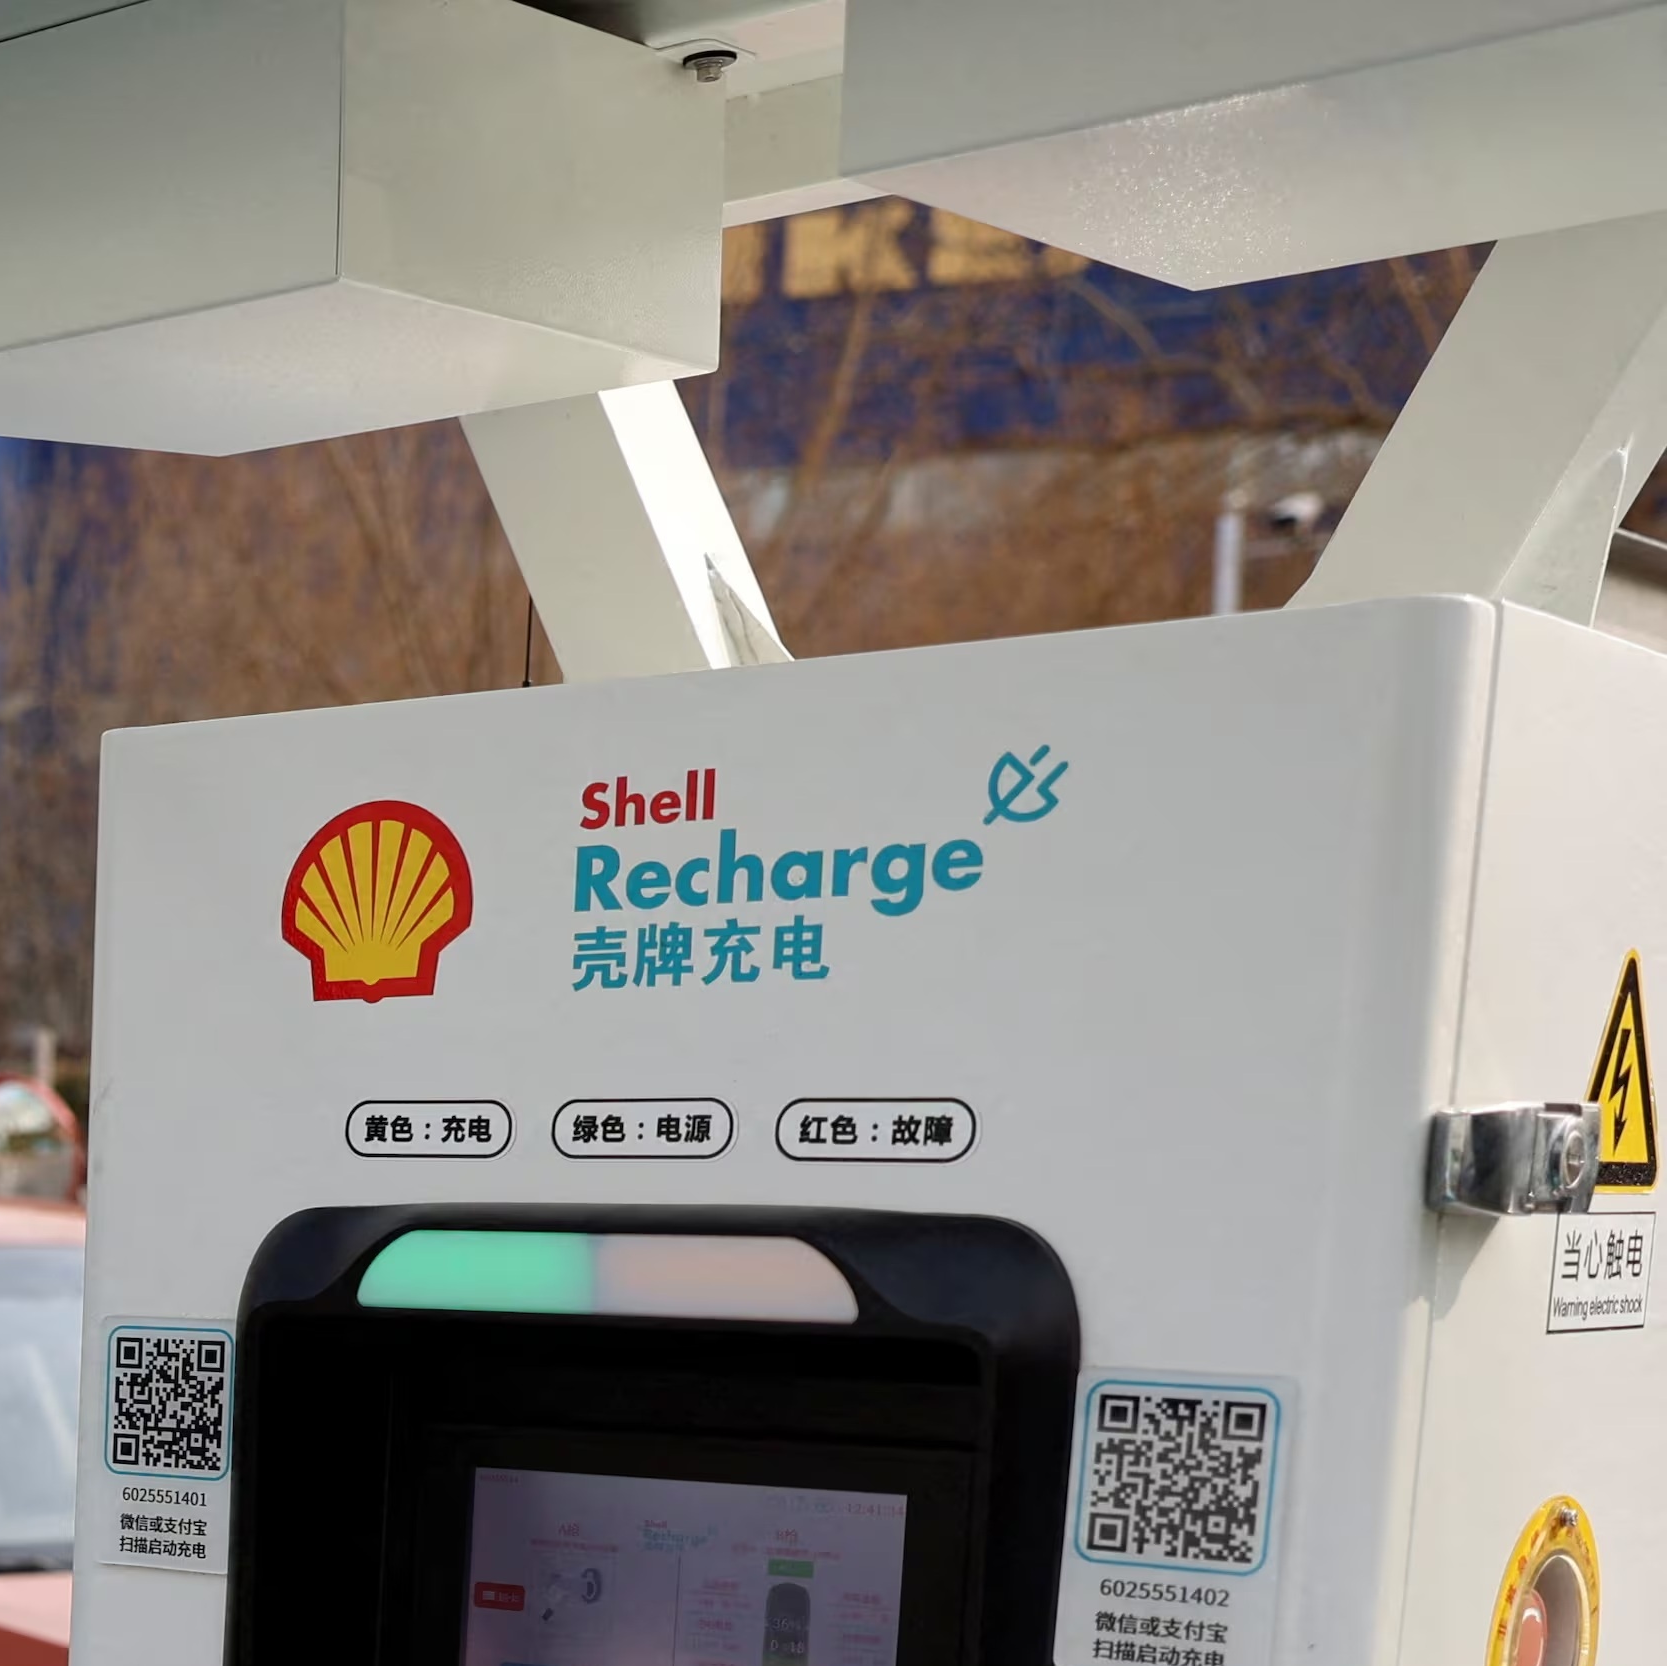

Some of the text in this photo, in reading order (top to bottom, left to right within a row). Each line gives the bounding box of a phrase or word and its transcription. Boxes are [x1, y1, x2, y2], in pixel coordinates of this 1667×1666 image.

[580, 768, 716, 831] Shell
[573, 829, 984, 917] Recharge
[571, 915, 831, 992] 壳牌充电
[1561, 1229, 1644, 1282] 当心触电
[1553, 1293, 1643, 1321] Warning electric shock
[122, 1486, 207, 1507] 6025551401
[119, 1513, 208, 1537] 微信或支付宝
[119, 1536, 207, 1559] 扫描启动充电
[1099, 1578, 1230, 1607] 6025551402
[1095, 1610, 1229, 1644] 微信或支付宝
